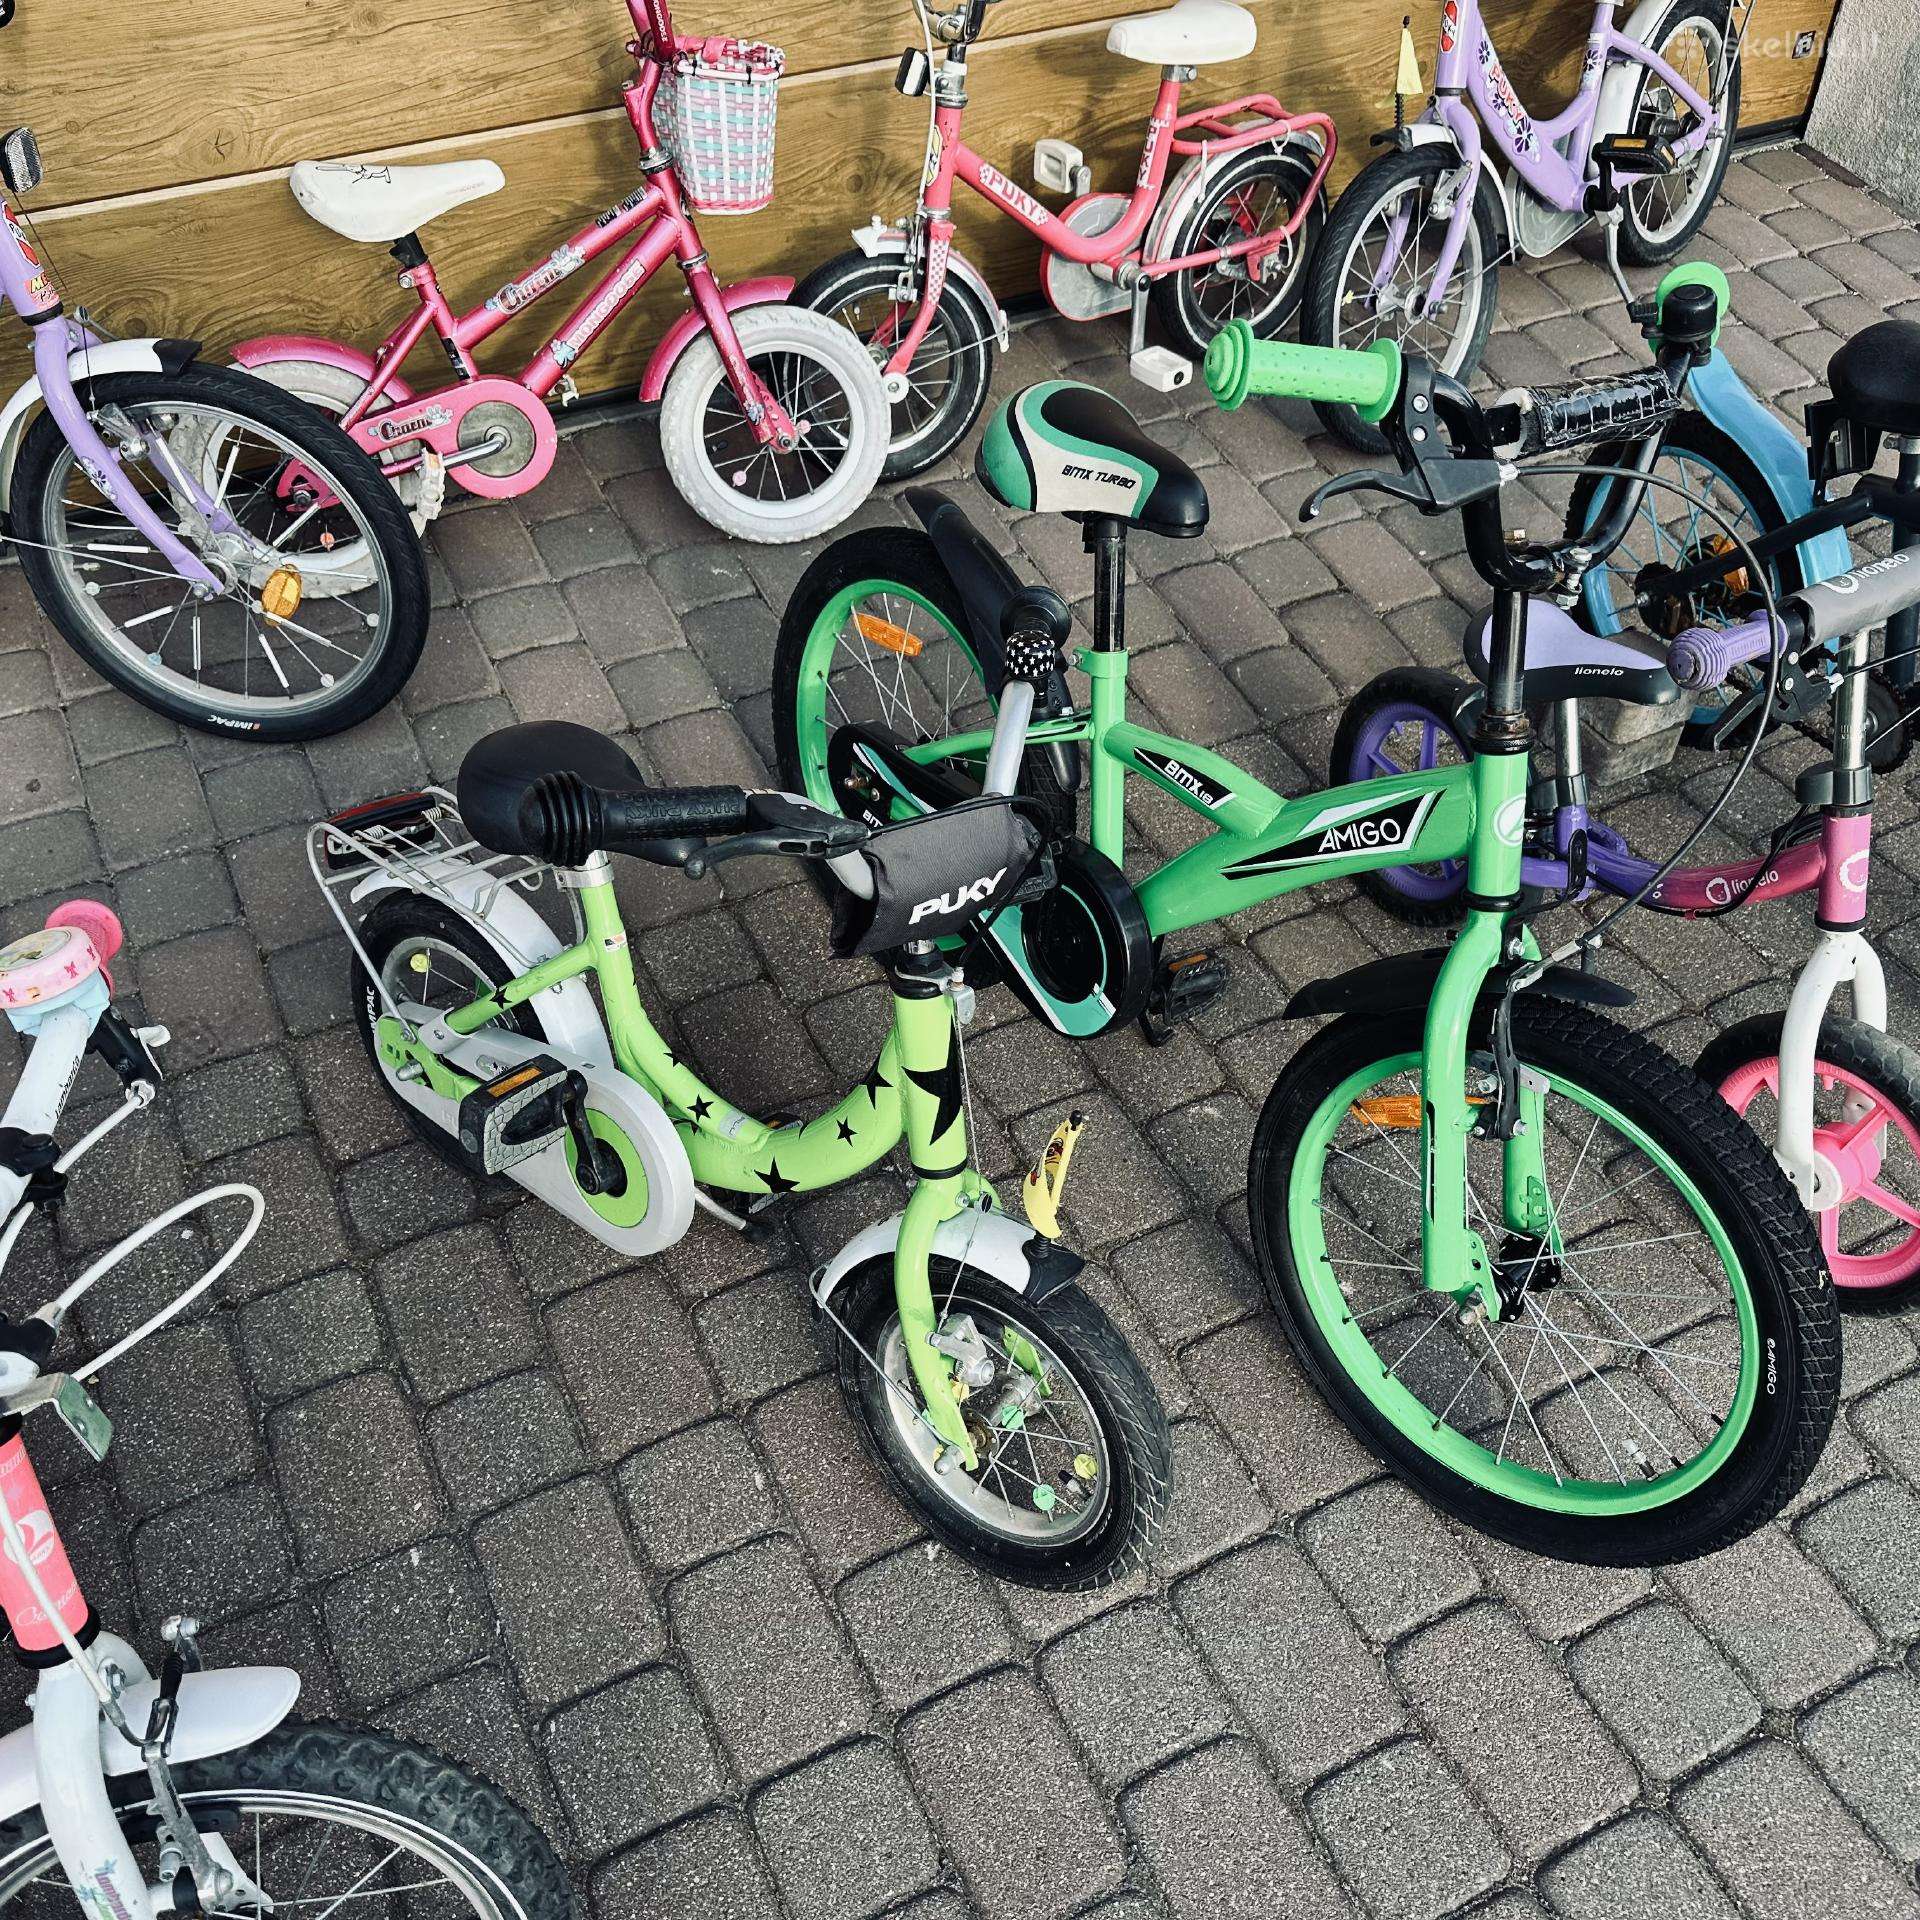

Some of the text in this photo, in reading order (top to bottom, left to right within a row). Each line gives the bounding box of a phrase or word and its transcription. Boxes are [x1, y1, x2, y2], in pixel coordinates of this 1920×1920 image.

[652, 0, 668, 43] ONGOOSE
[1140, 125, 1157, 181] PUKY
[988, 170, 1039, 217] PUKY
[570, 259, 646, 348] MONGOOSE
[1061, 464, 1137, 490] BMX TURBO
[1574, 666, 1625, 676] lionelo
[207, 714, 254, 730] IMPAC
[1318, 818, 1401, 853] AMIGO
[908, 867, 1008, 925] PUKY
[1731, 869, 1780, 895] lioelo
